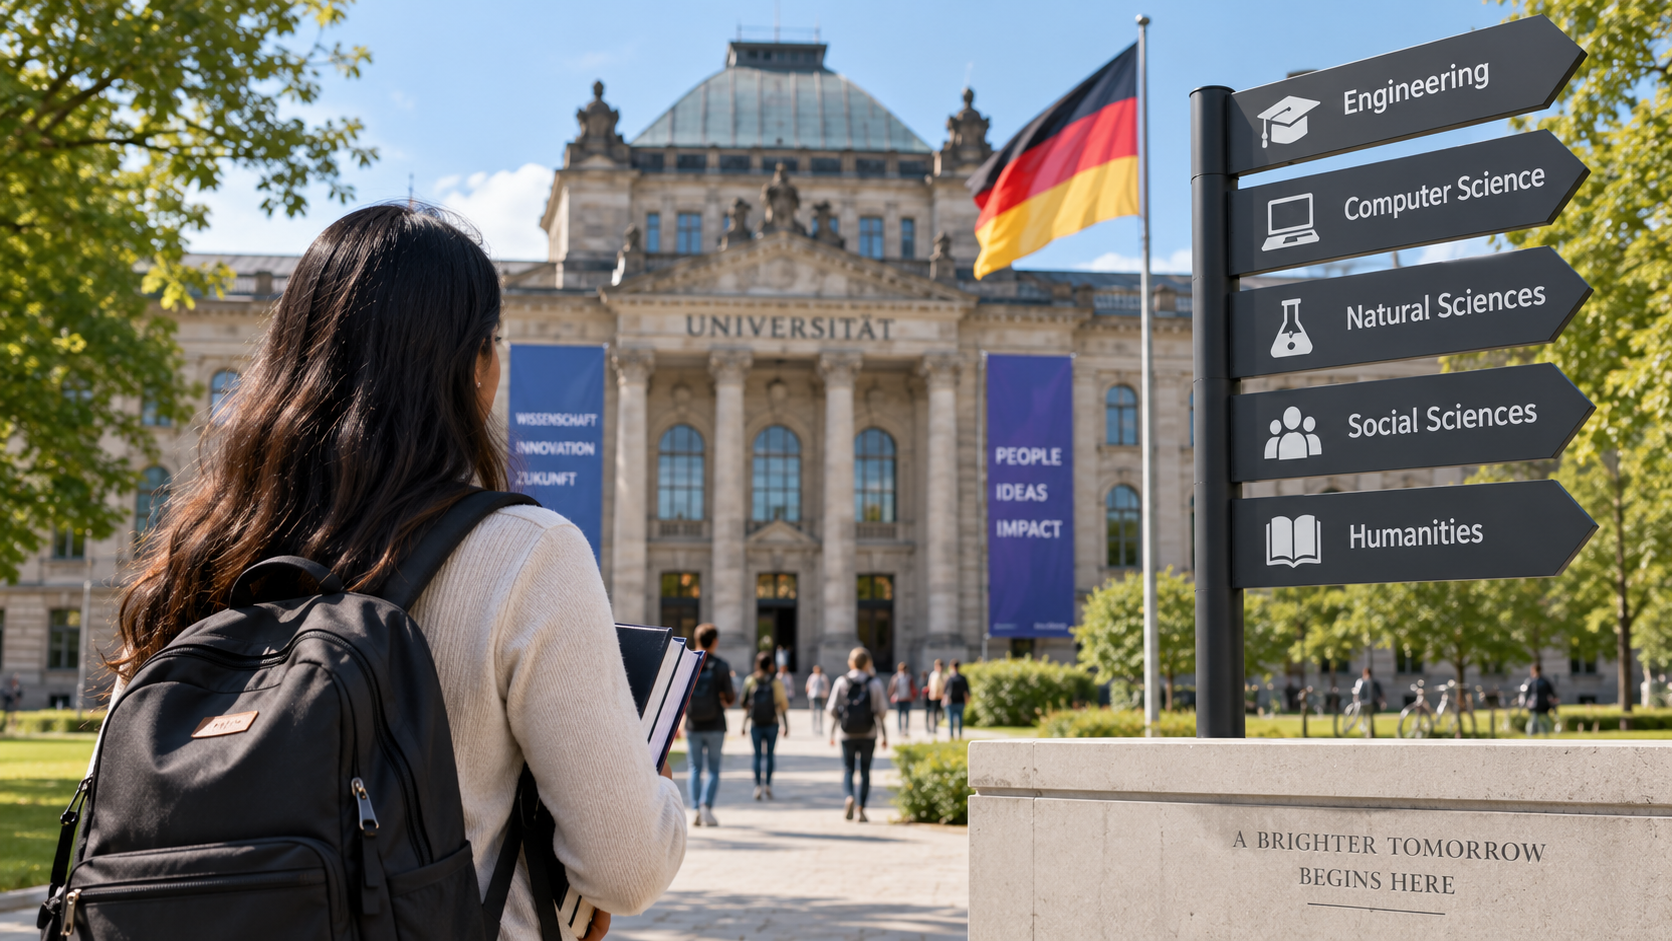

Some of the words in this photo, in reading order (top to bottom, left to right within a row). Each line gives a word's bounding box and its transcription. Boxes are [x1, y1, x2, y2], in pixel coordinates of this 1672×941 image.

[1343, 62, 1490, 115] Engineering
[1344, 182, 1451, 221] Computer
[1457, 167, 1545, 201] Science
[1346, 294, 1430, 330] Natural
[1437, 285, 1546, 319] Sciences
[685, 314, 896, 340] UNIVERSITÄT
[515, 412, 598, 427] WISSENSCHAFT
[1348, 406, 1418, 439] Social
[1426, 403, 1538, 432] Sciences
[995, 446, 1062, 466] PEOPLE
[996, 483, 1049, 502] IDEAS
[996, 519, 1063, 539] IMPACT
[1349, 518, 1484, 549] Humanities
[1232, 830, 1247, 849] A
[1257, 831, 1378, 855] BRIGHTER
[1387, 836, 1546, 863] TOMORROW
[1298, 867, 1382, 891] BEGINS
[1390, 872, 1456, 895] HERE
